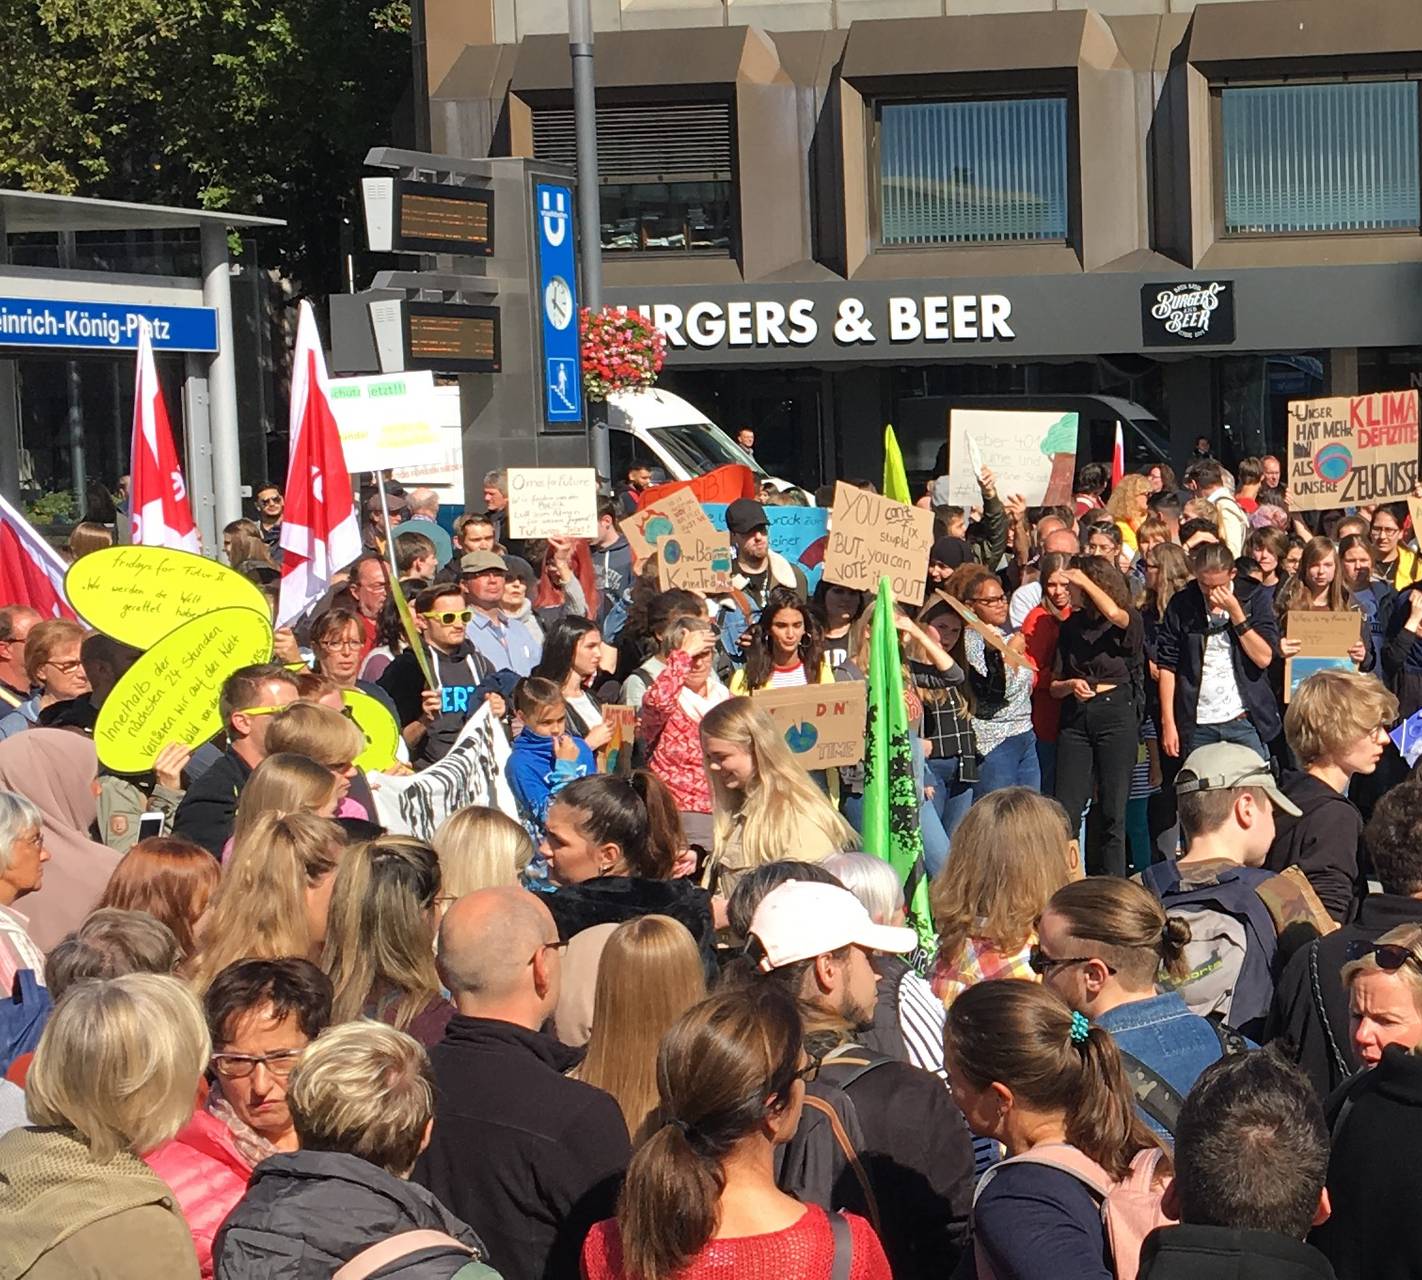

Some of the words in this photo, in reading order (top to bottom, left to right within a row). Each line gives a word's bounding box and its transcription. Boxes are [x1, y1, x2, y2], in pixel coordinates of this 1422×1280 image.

[834, 297, 877, 343] &
[889, 294, 1016, 341] BEER
[1165, 309, 1210, 333] BEER
[1350, 391, 1417, 428] KLIMA
[1296, 422, 1321, 441] HAT
[1323, 420, 1354, 438] MEHR
[1357, 423, 1418, 449] DEFIZITE
[1292, 460, 1315, 478] ALS
[1339, 460, 1418, 503] ZEUGNISSE
[1294, 481, 1338, 496] UNSERE
[840, 488, 880, 526] YOU
[880, 532, 909, 549] stupid
[901, 520, 919, 538] fix
[867, 548, 889, 566] you
[890, 555, 911, 570] can
[835, 560, 868, 580] VOTE
[892, 576, 925, 599] OUT
[100, 680, 151, 742] Innerhalb
[154, 655, 171, 678] der
[188, 676, 216, 697] auf
[128, 688, 165, 738] nächsten
[165, 669, 182, 687] 24
